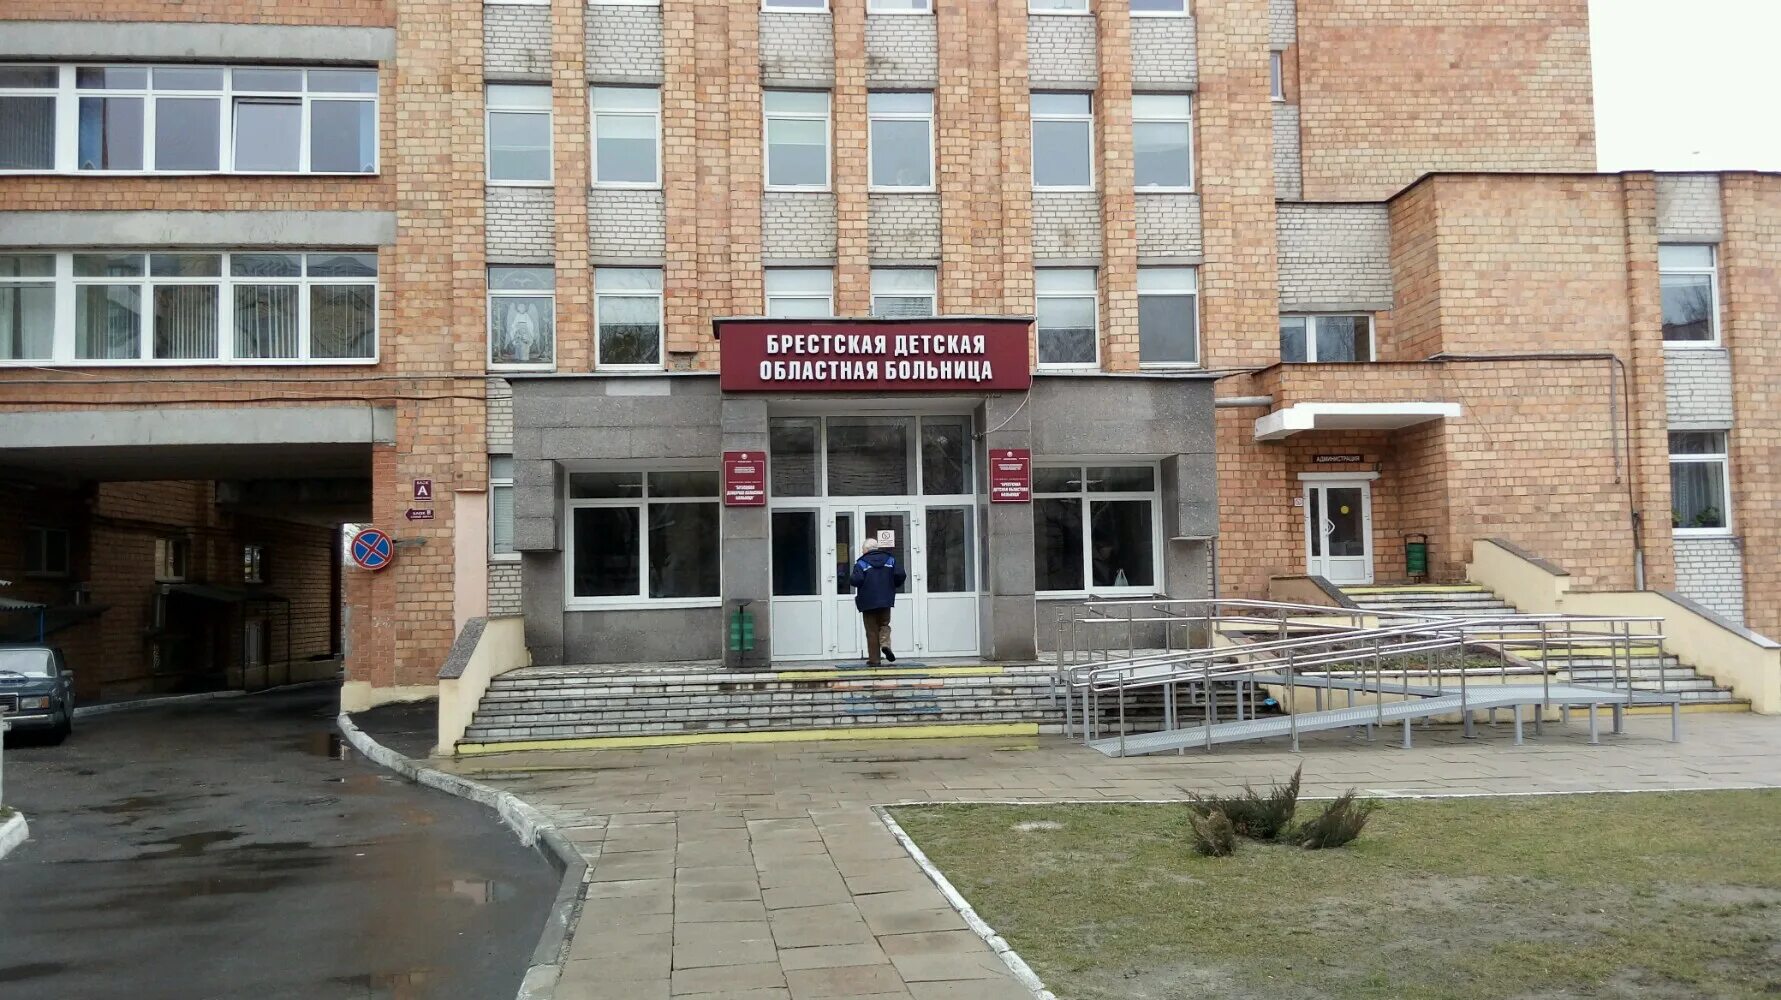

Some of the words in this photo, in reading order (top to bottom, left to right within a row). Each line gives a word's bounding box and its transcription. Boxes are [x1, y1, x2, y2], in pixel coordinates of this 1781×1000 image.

[766, 335, 887, 354] БРЕСТСКАЯ
[894, 335, 985, 356] ДЕТСКАЯ
[759, 360, 879, 380] ОБЛАСТНАЯ
[885, 360, 993, 381] БОЛЬНИЦА
[417, 485, 428, 495] А
